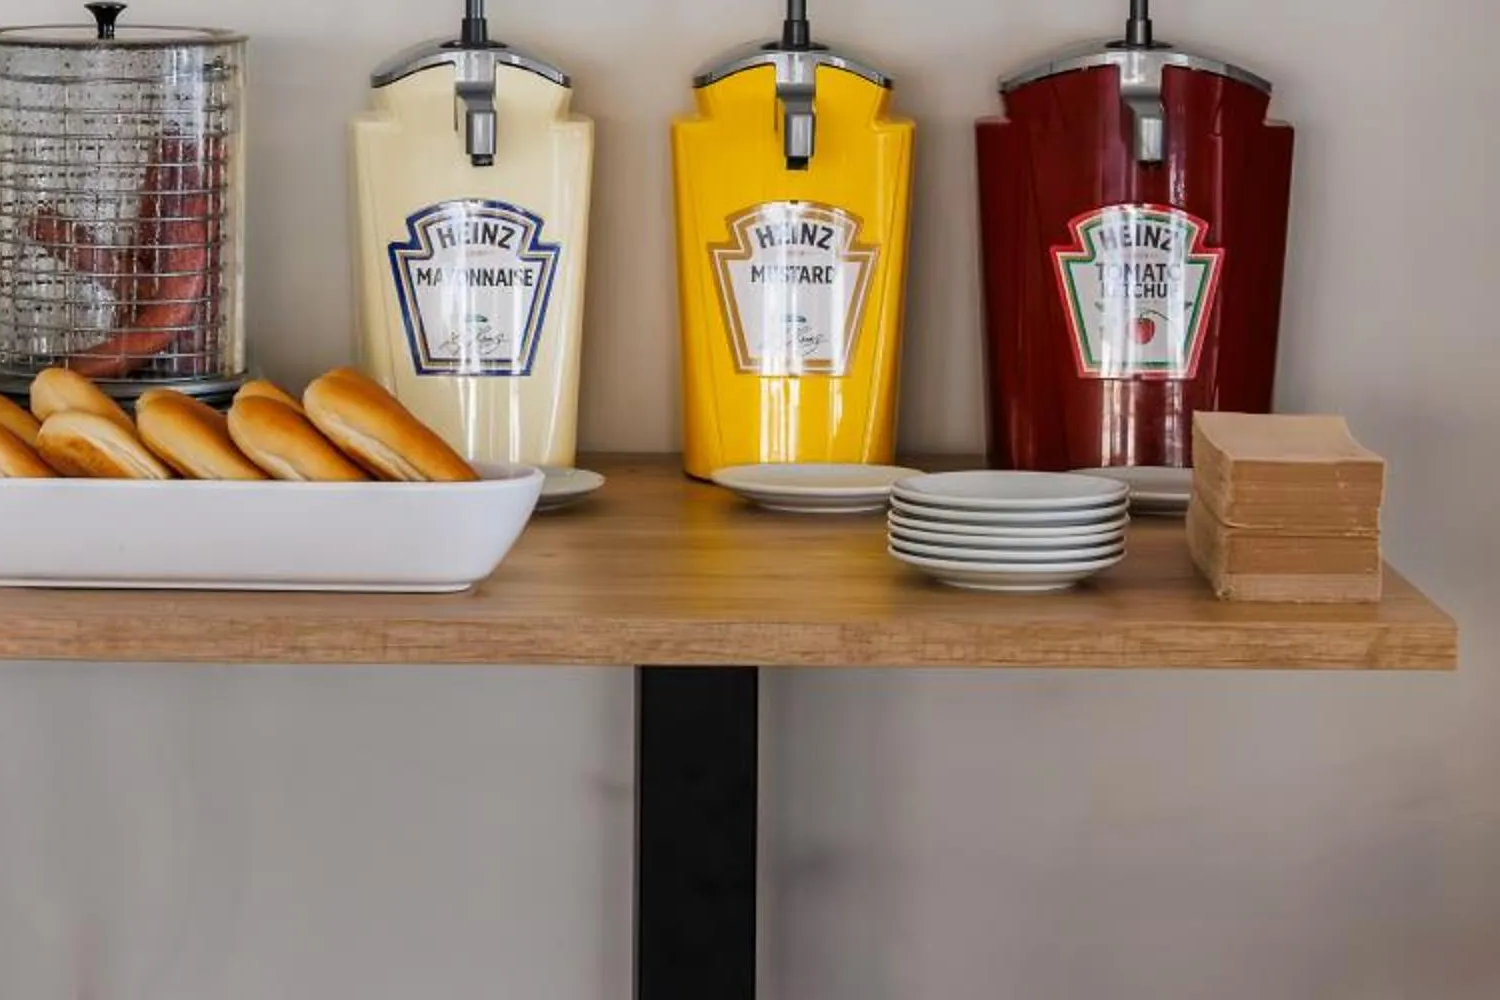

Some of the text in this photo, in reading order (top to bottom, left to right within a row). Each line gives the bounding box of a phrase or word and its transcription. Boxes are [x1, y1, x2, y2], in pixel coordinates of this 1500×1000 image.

[437, 221, 516, 249] HEINZ
[1099, 223, 1179, 251] HEINZ
[1095, 263, 1181, 282] TOMATO
